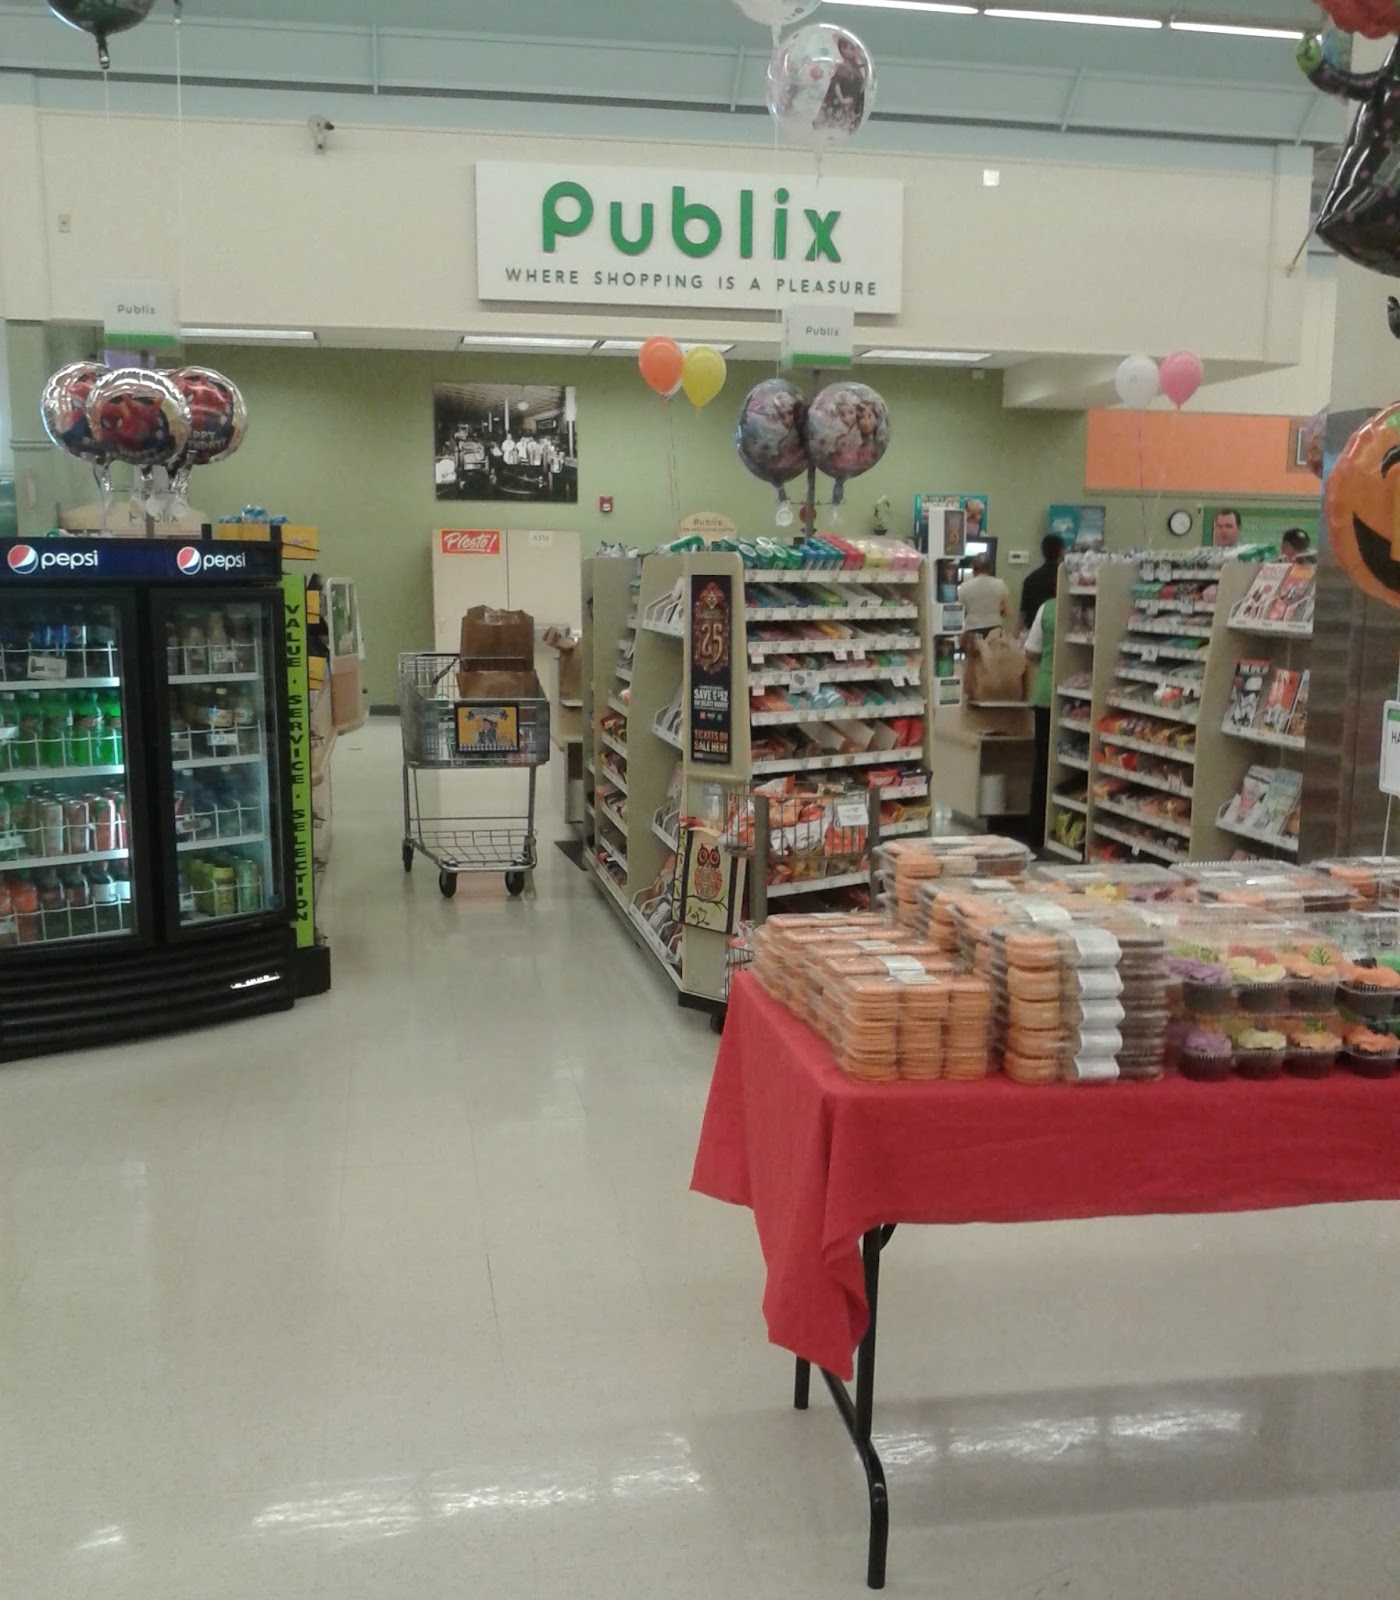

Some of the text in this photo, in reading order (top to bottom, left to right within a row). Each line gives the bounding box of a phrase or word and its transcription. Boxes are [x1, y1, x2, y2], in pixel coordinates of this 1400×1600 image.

[542, 181, 842, 262] Publix
[505, 267, 877, 296] WHERE SHOPPING IS A PLEASURE
[117, 304, 156, 315] Publix
[805, 326, 839, 336] Publix
[41, 549, 98, 570] pepsi
[203, 551, 246, 571] pepsi
[285, 604, 301, 668] VALUE
[701, 623, 723, 665] 25
[693, 688, 712, 701] SAVE
[288, 694, 304, 785] SERVICE
